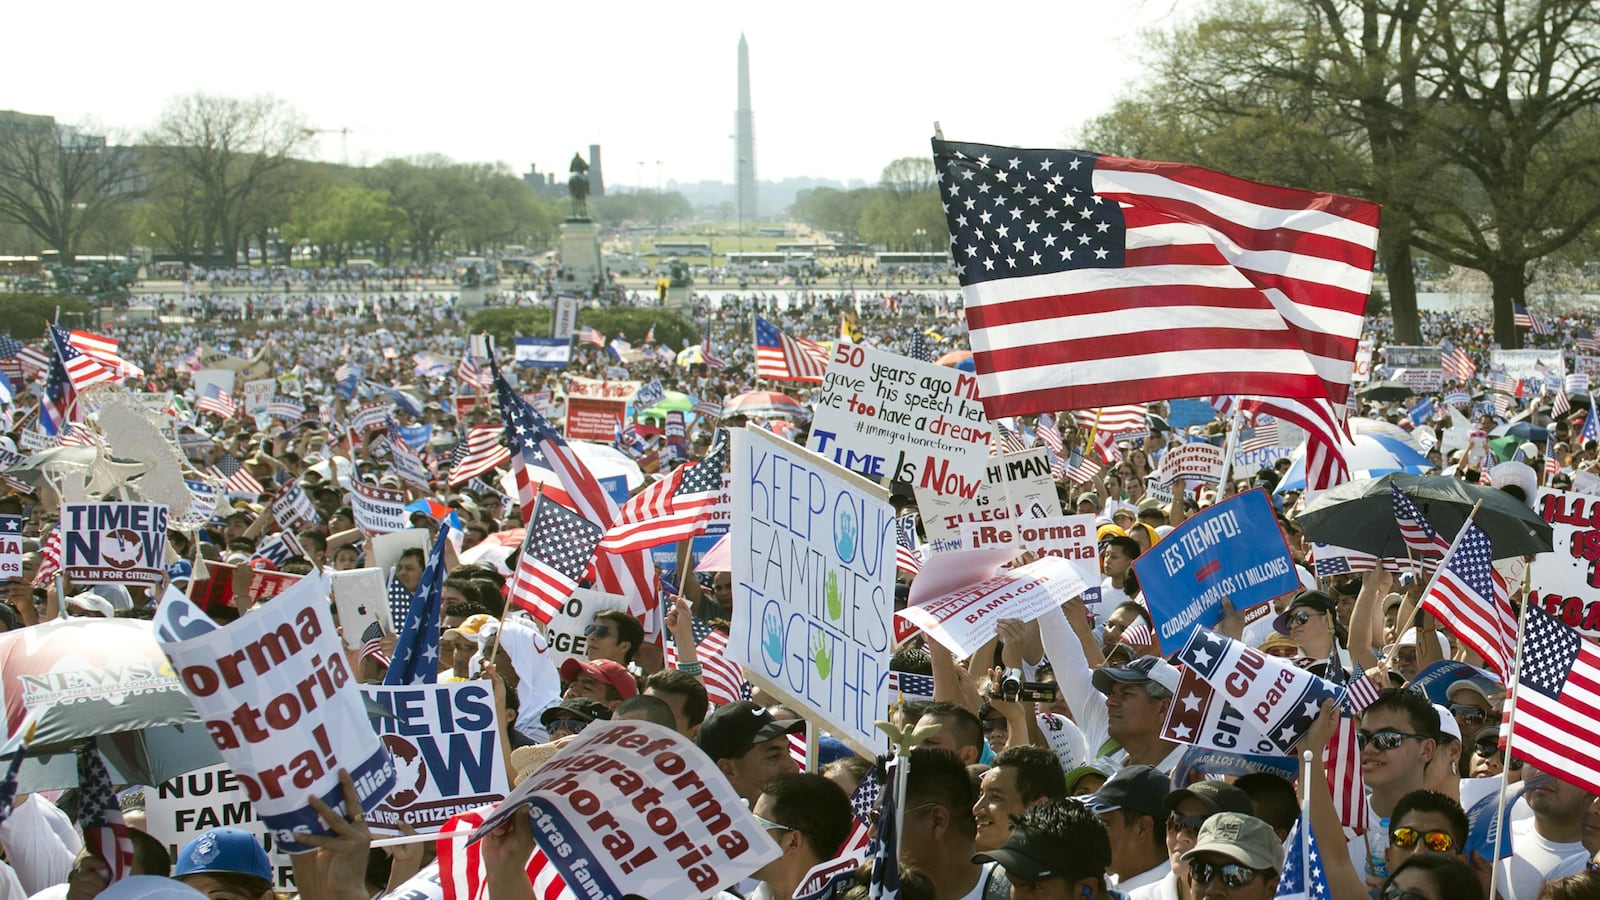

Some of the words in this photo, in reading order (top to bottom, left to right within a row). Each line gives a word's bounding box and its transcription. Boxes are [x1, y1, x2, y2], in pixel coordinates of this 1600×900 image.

[823, 371, 866, 393] gave
[876, 380, 899, 401] his
[904, 392, 953, 414] speech
[835, 343, 865, 368] 50
[870, 362, 917, 386] years
[920, 376, 952, 399] ago
[847, 393, 876, 416] too
[878, 402, 911, 426] have
[915, 416, 927, 431] a
[813, 429, 885, 477] TIME
[750, 446, 826, 541] KEEP
[976, 495, 989, 506] is
[67, 505, 149, 531] TIME
[153, 506, 168, 533] IS
[1162, 544, 1185, 577] ¡ES
[1180, 510, 1242, 561] TIEMPO!
[0, 537, 20, 555] ÍA
[1, 563, 19, 571] es
[88, 570, 100, 579] IN
[103, 570, 123, 579] FOR
[125, 570, 153, 579] CITIZE
[749, 516, 888, 652] FAMILIES
[1161, 597, 1203, 639] CIUDADANÍA
[1200, 585, 1221, 612] PARA
[1218, 579, 1237, 598] LOS
[1236, 572, 1247, 591] 11
[1245, 556, 1290, 587] MILLONES
[964, 575, 1049, 624] BAMN.com
[181, 606, 322, 698] orma
[1225, 646, 1267, 698] CIU
[206, 652, 349, 750] atoria
[360, 690, 431, 736] ME
[435, 685, 494, 734] IS
[1253, 668, 1296, 724] para
[236, 723, 338, 802] ora!
[1215, 756, 1234, 767] LOS
[176, 799, 262, 832] FAM
[566, 856, 616, 900] fami
